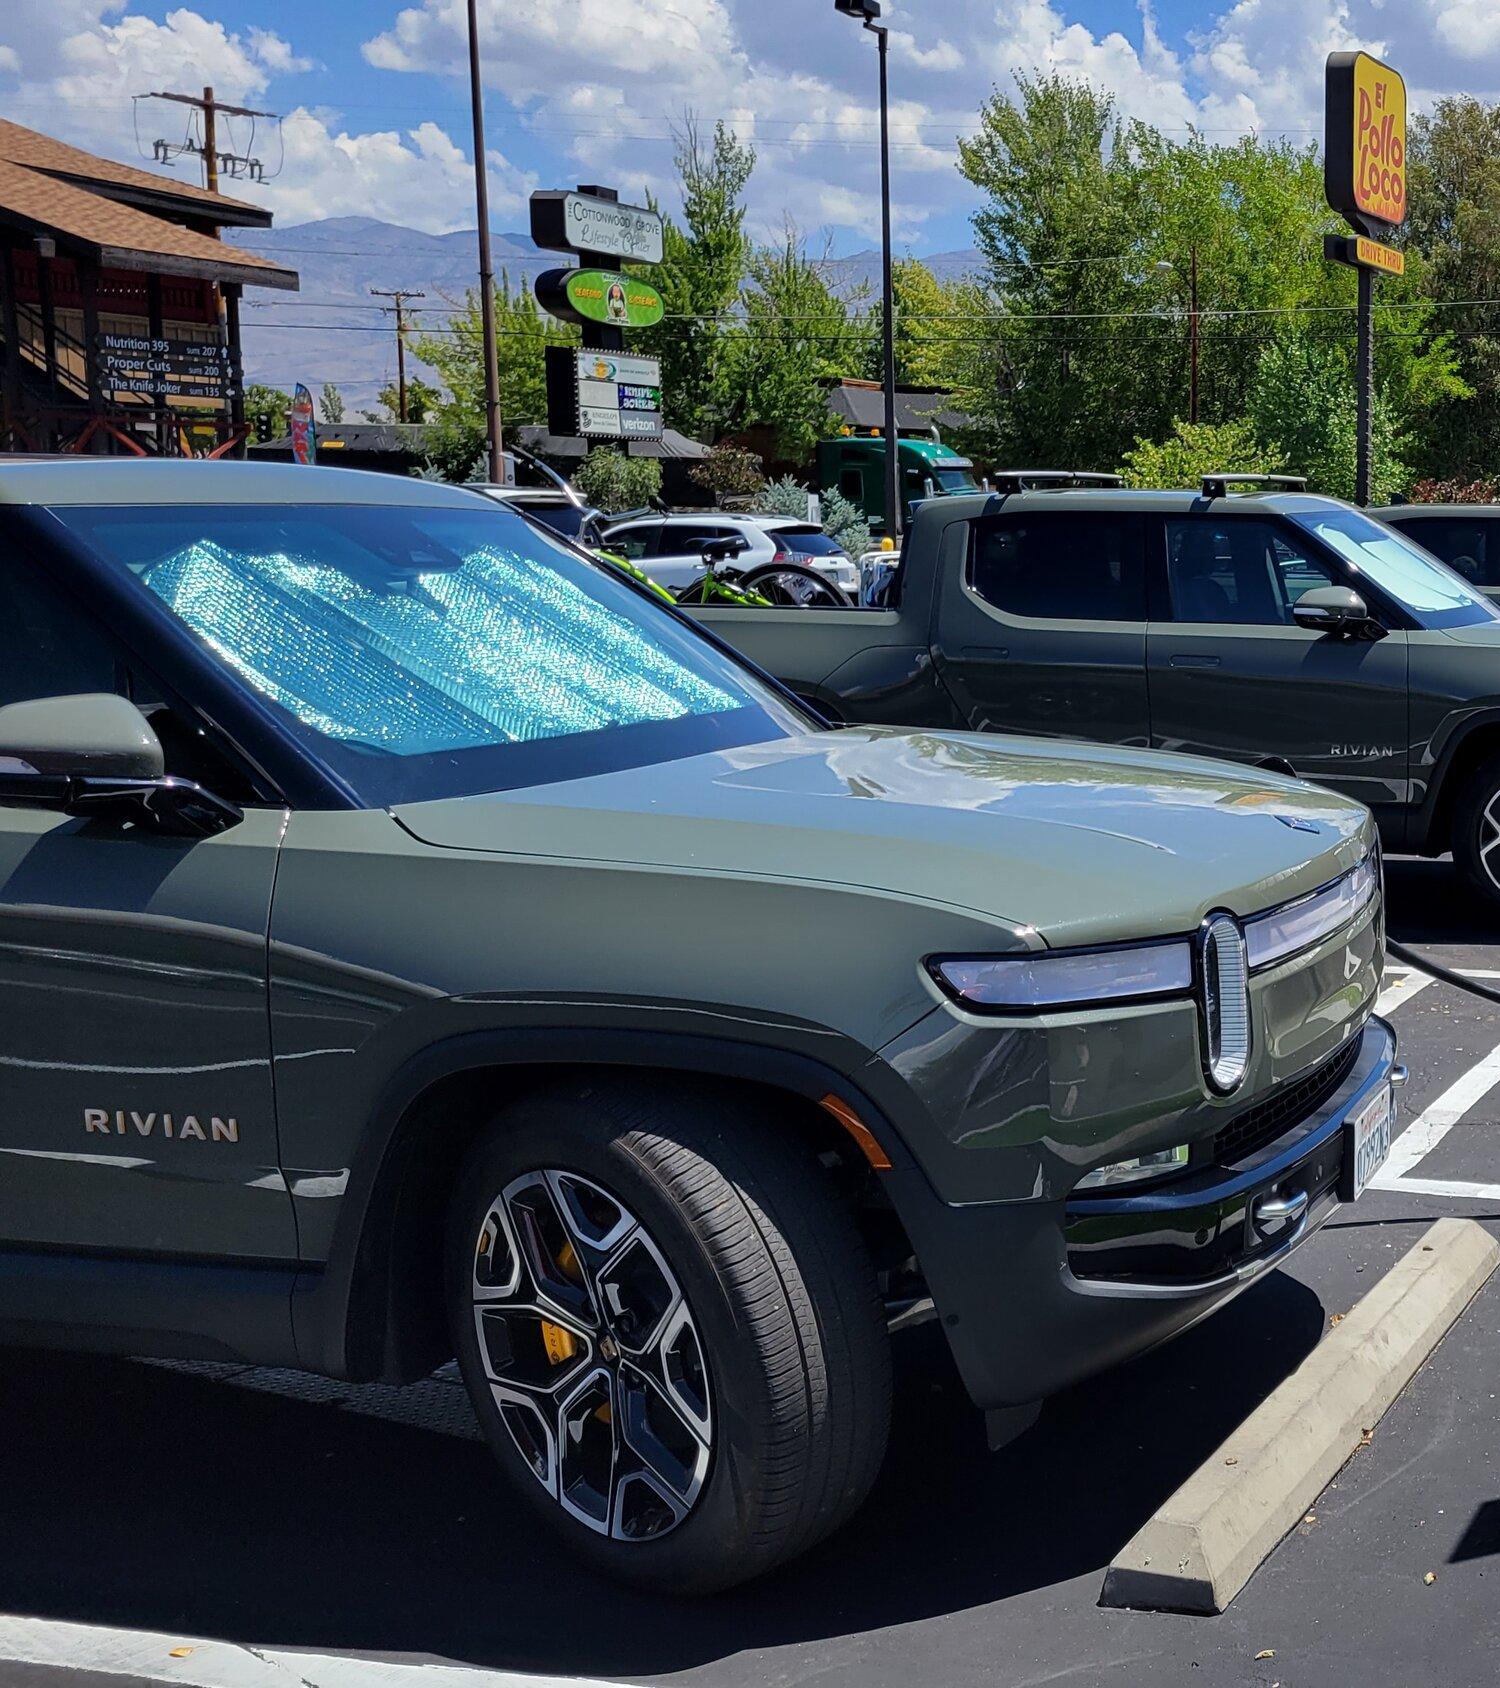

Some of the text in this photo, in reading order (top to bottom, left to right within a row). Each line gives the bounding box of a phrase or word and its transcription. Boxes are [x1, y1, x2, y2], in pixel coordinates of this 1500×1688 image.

[1375, 81, 1387, 111] El
[1358, 87, 1403, 168] Pollo
[1360, 144, 1403, 204] Loco
[581, 224, 619, 248] Lifestyle
[1360, 239, 1401, 271] DRIVE THRU
[105, 335, 150, 351] Nutrition
[151, 340, 170, 353] 395
[202, 346, 217, 356] 207
[107, 355, 145, 371] Proper
[146, 359, 172, 372] Cuts
[204, 366, 220, 376] 200
[108, 377, 128, 390] The
[129, 379, 154, 393] Knife
[156, 381, 182, 394] Joker
[205, 386, 220, 397] 135
[623, 418, 656, 431] verizon
[1330, 744, 1393, 757] RIVIAN
[84, 1108, 239, 1143] RIVIAN
